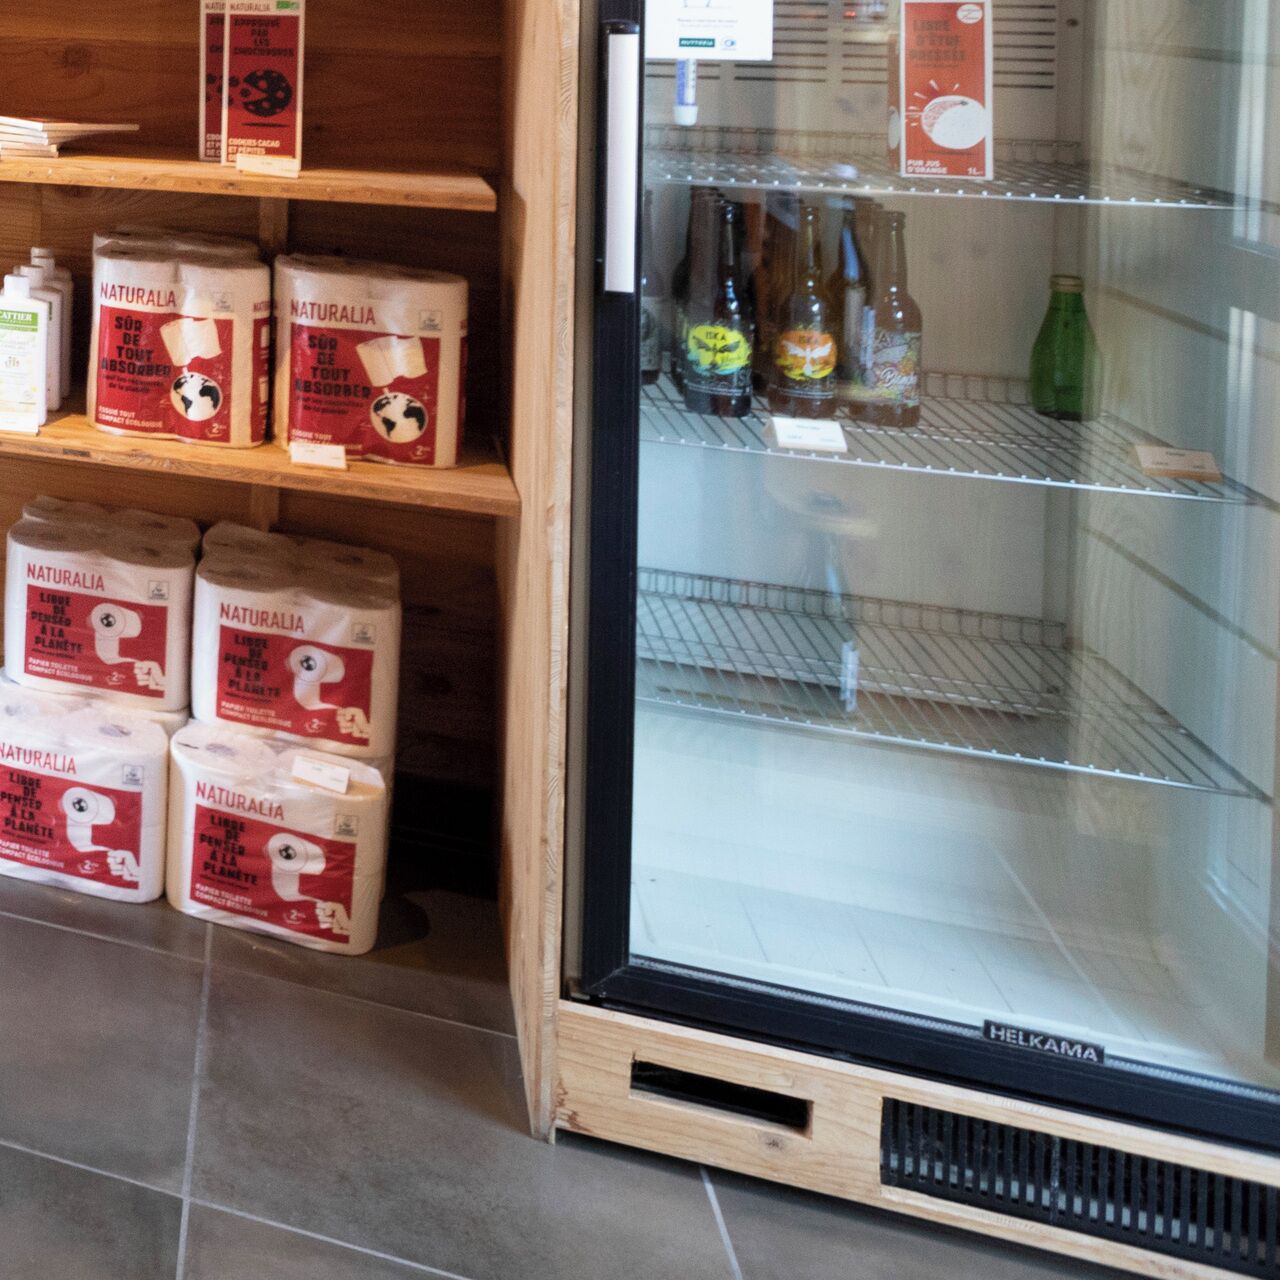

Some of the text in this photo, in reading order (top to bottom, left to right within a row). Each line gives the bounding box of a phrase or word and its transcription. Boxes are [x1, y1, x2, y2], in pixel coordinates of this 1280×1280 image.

[100, 282, 176, 307] NATURALIA
[291, 300, 376, 325] NATURALIA
[115, 315, 142, 331] SÛR
[123, 333, 138, 345] DE
[309, 334, 337, 350] SÛR
[116, 346, 154, 361] TOUT
[317, 352, 335, 365] DE
[102, 359, 171, 377] ABSORBER
[311, 367, 350, 381] TOUT
[295, 379, 372, 398] ABSORBER
[27, 563, 104, 591] NATURALIA
[40, 593, 70, 606] LIBRE
[220, 603, 304, 632] NATURALIA
[9, 773, 41, 788] LIBRE
[23, 787, 36, 797] DE
[196, 782, 284, 820] NATURALIA
[989, 1022, 1099, 1062] HELKAMA
